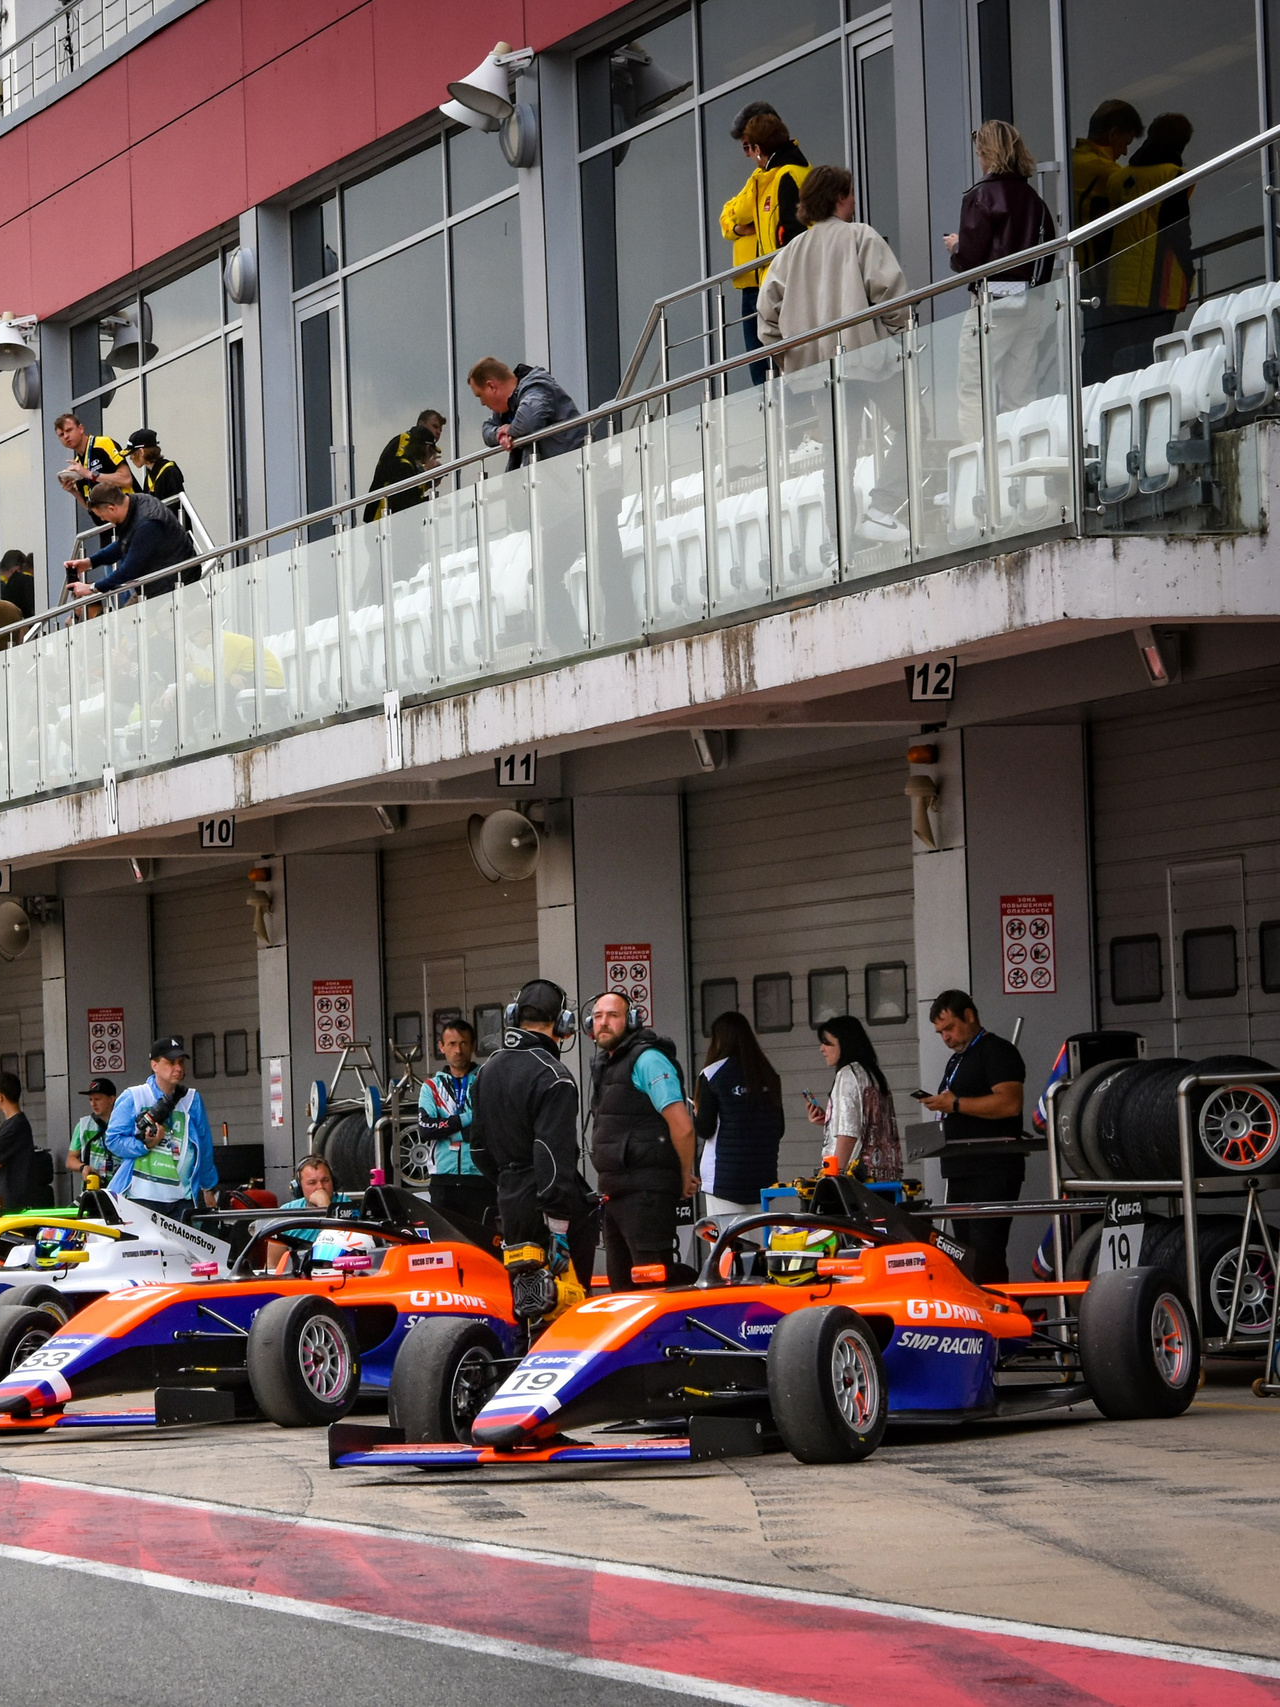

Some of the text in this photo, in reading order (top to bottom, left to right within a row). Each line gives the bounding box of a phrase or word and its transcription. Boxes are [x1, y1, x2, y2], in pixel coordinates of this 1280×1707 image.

[916, 662, 951, 695] 12
[504, 753, 531, 781] 11
[205, 819, 231, 843] 10
[160, 1217, 217, 1254] TechAtomStroy
[1108, 1232, 1131, 1270] 19
[897, 1331, 984, 1355] SMP RACING
[21, 1350, 71, 1368] 33
[511, 1372, 559, 1391] 19
